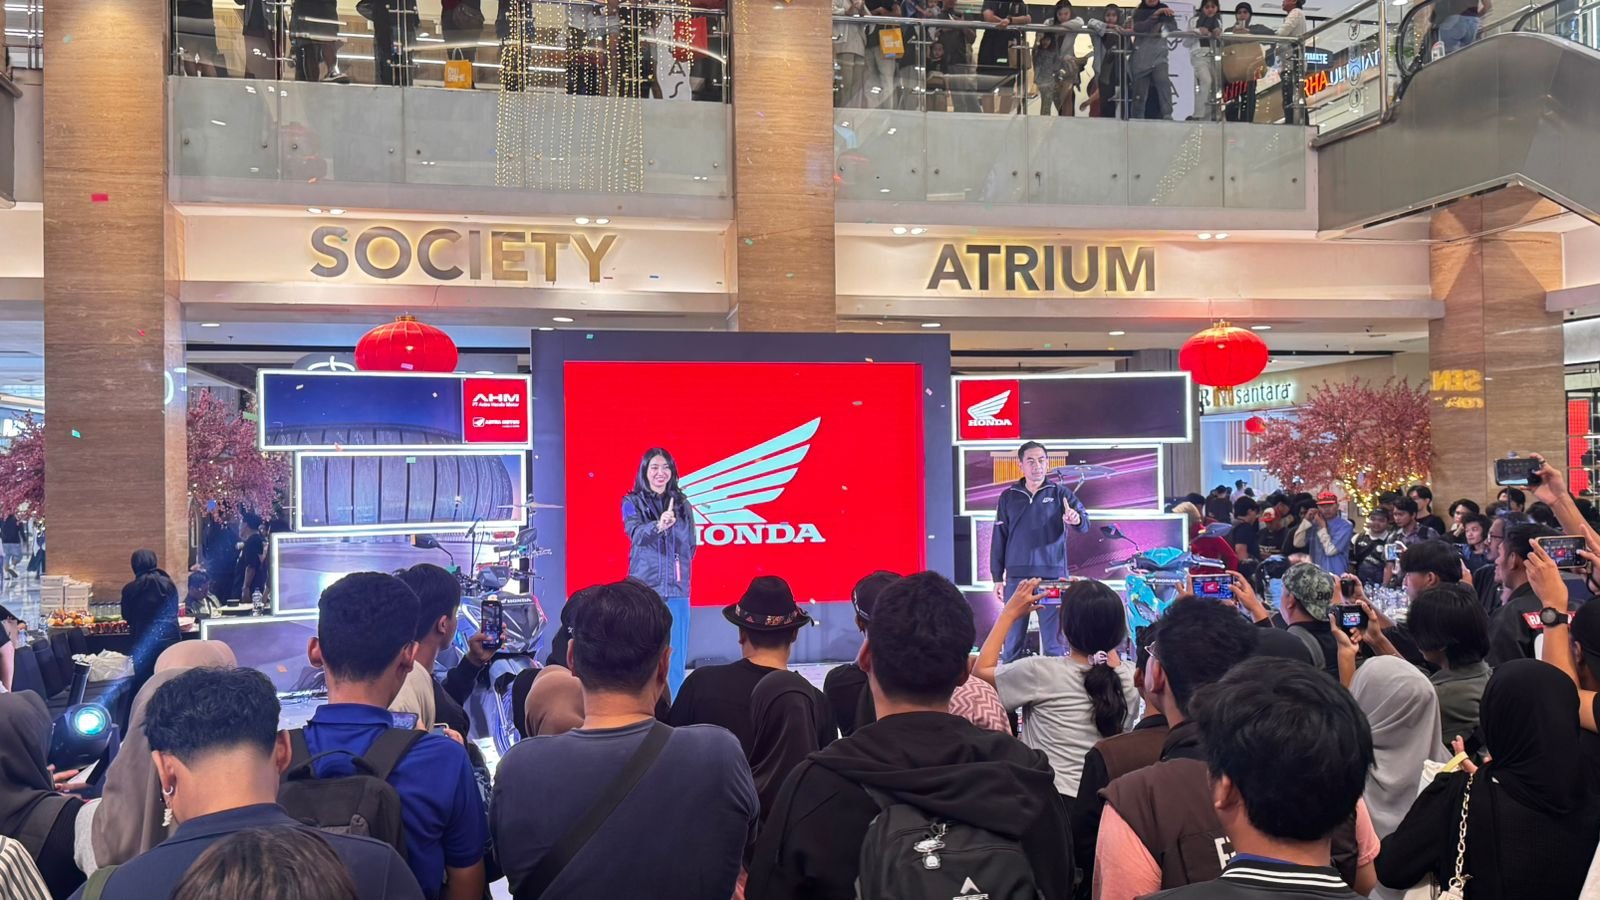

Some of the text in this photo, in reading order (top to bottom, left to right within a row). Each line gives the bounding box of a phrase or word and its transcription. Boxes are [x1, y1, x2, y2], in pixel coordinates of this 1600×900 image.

[310, 226, 617, 283] SOCIETY
[926, 243, 1156, 292] ATRIUM
[472, 393, 520, 402] AHM
